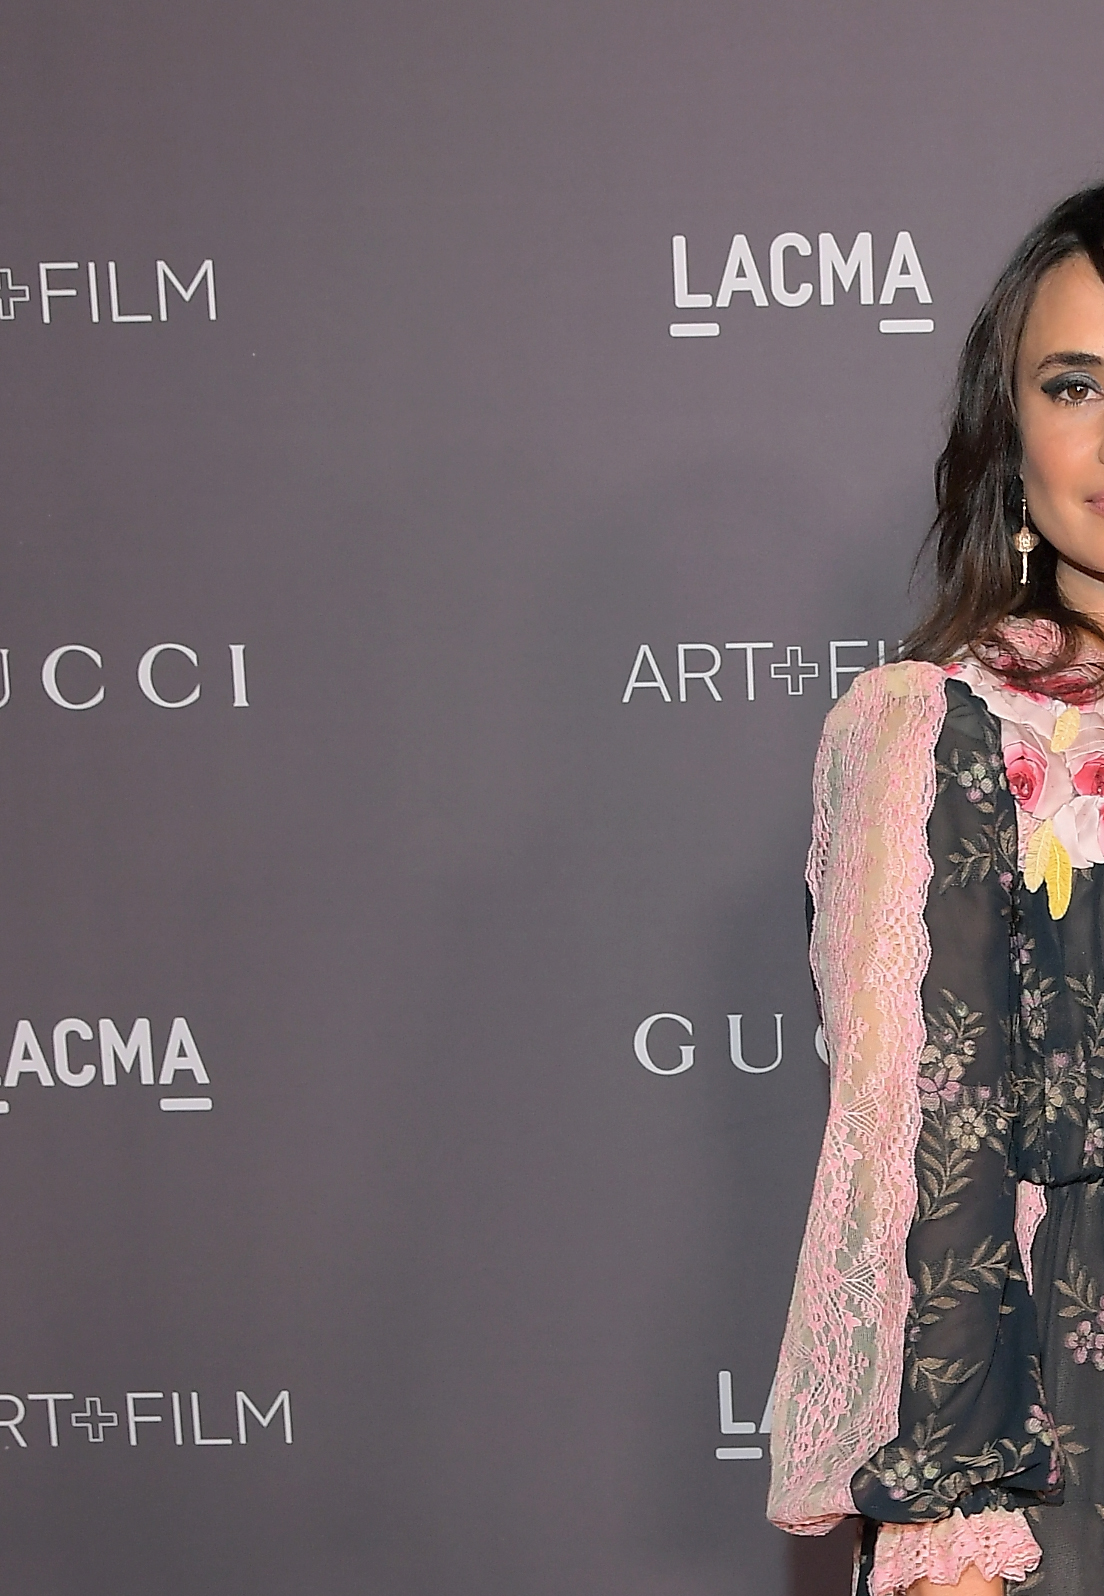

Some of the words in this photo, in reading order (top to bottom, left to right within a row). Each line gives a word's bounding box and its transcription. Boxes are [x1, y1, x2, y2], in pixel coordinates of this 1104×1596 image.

[672, 231, 933, 308] LACMA
[0, 643, 249, 710] CCI
[622, 639, 904, 704] ART+F
[0, 1017, 211, 1088] ACMA
[633, 1012, 829, 1076] GU
[0, 1390, 293, 1448] RT+FILM
[718, 1370, 771, 1435] L
